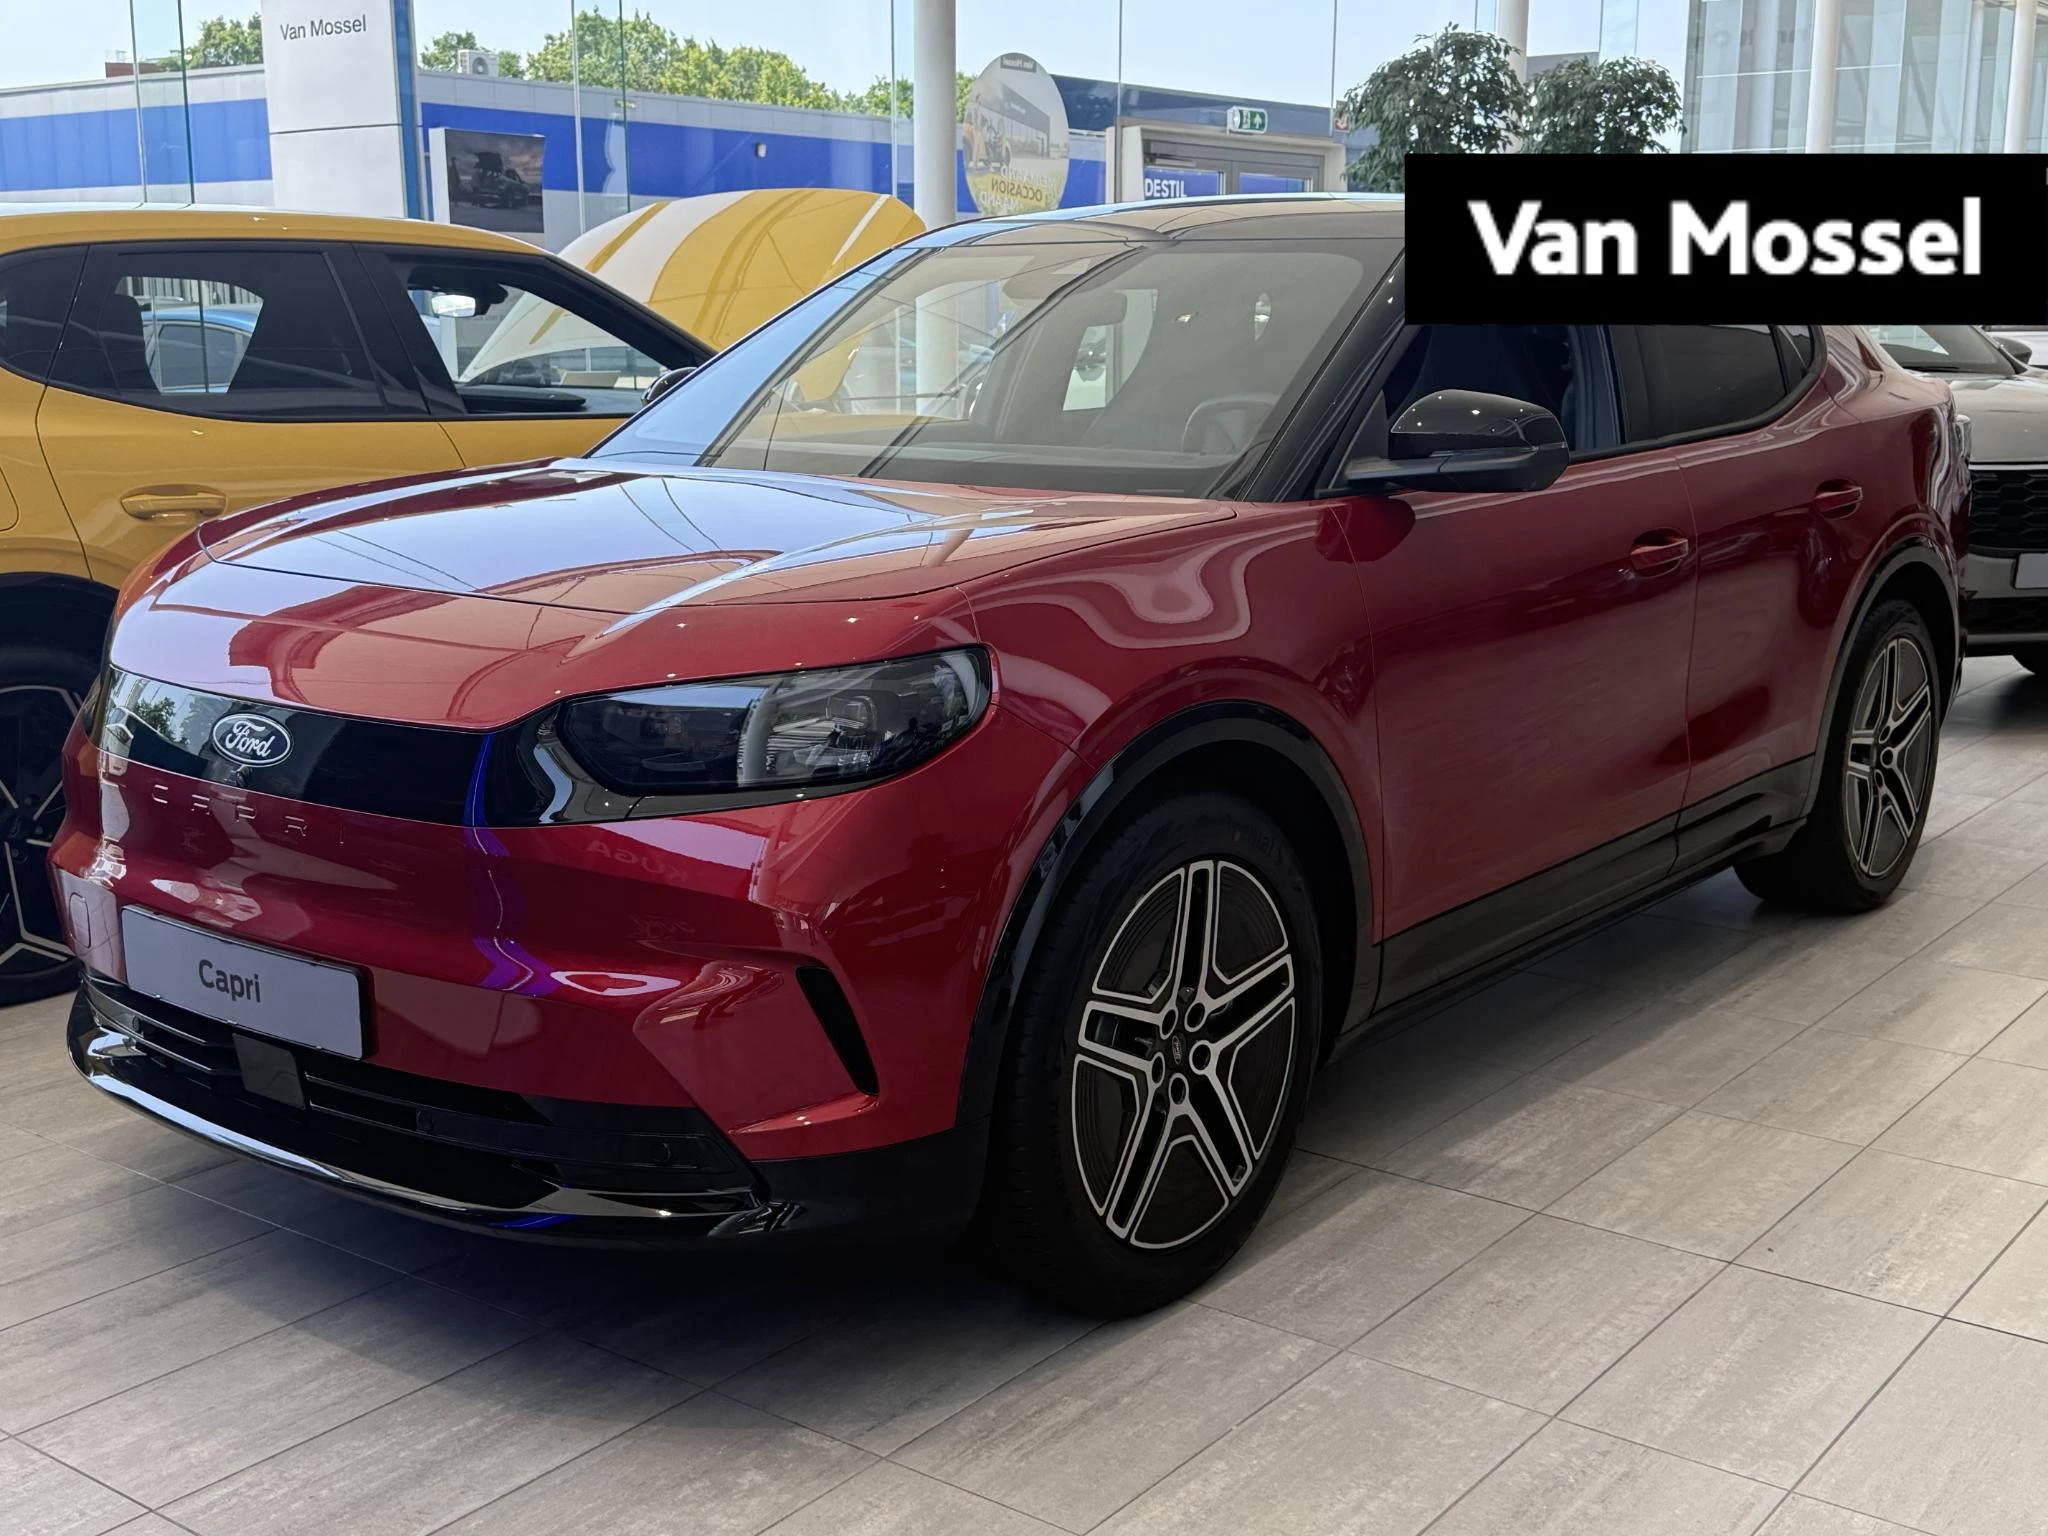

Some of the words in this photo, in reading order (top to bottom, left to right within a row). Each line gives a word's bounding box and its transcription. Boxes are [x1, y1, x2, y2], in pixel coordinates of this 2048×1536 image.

[280, 23, 306, 40] Van
[310, 14, 367, 37] Mossel
[1144, 178, 1188, 198] DESTIL
[225, 720, 276, 757] Ford
[198, 959, 261, 1003] Capri
